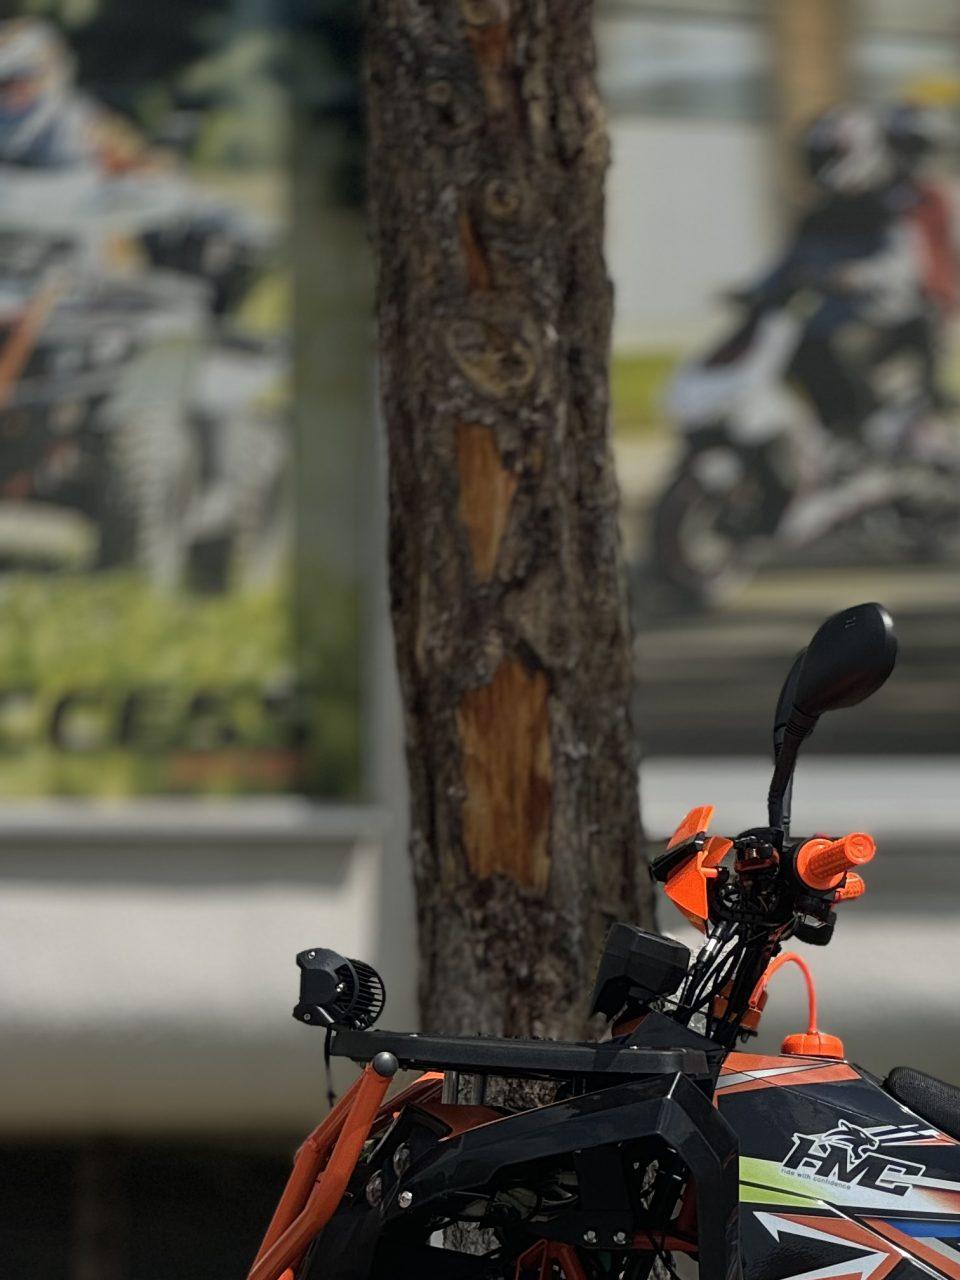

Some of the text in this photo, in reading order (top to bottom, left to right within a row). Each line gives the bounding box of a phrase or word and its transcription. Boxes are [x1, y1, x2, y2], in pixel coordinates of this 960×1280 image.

[781, 1132, 926, 1197] HMC
[781, 1168, 796, 1176] ride
[813, 1176, 852, 1190] confidence
